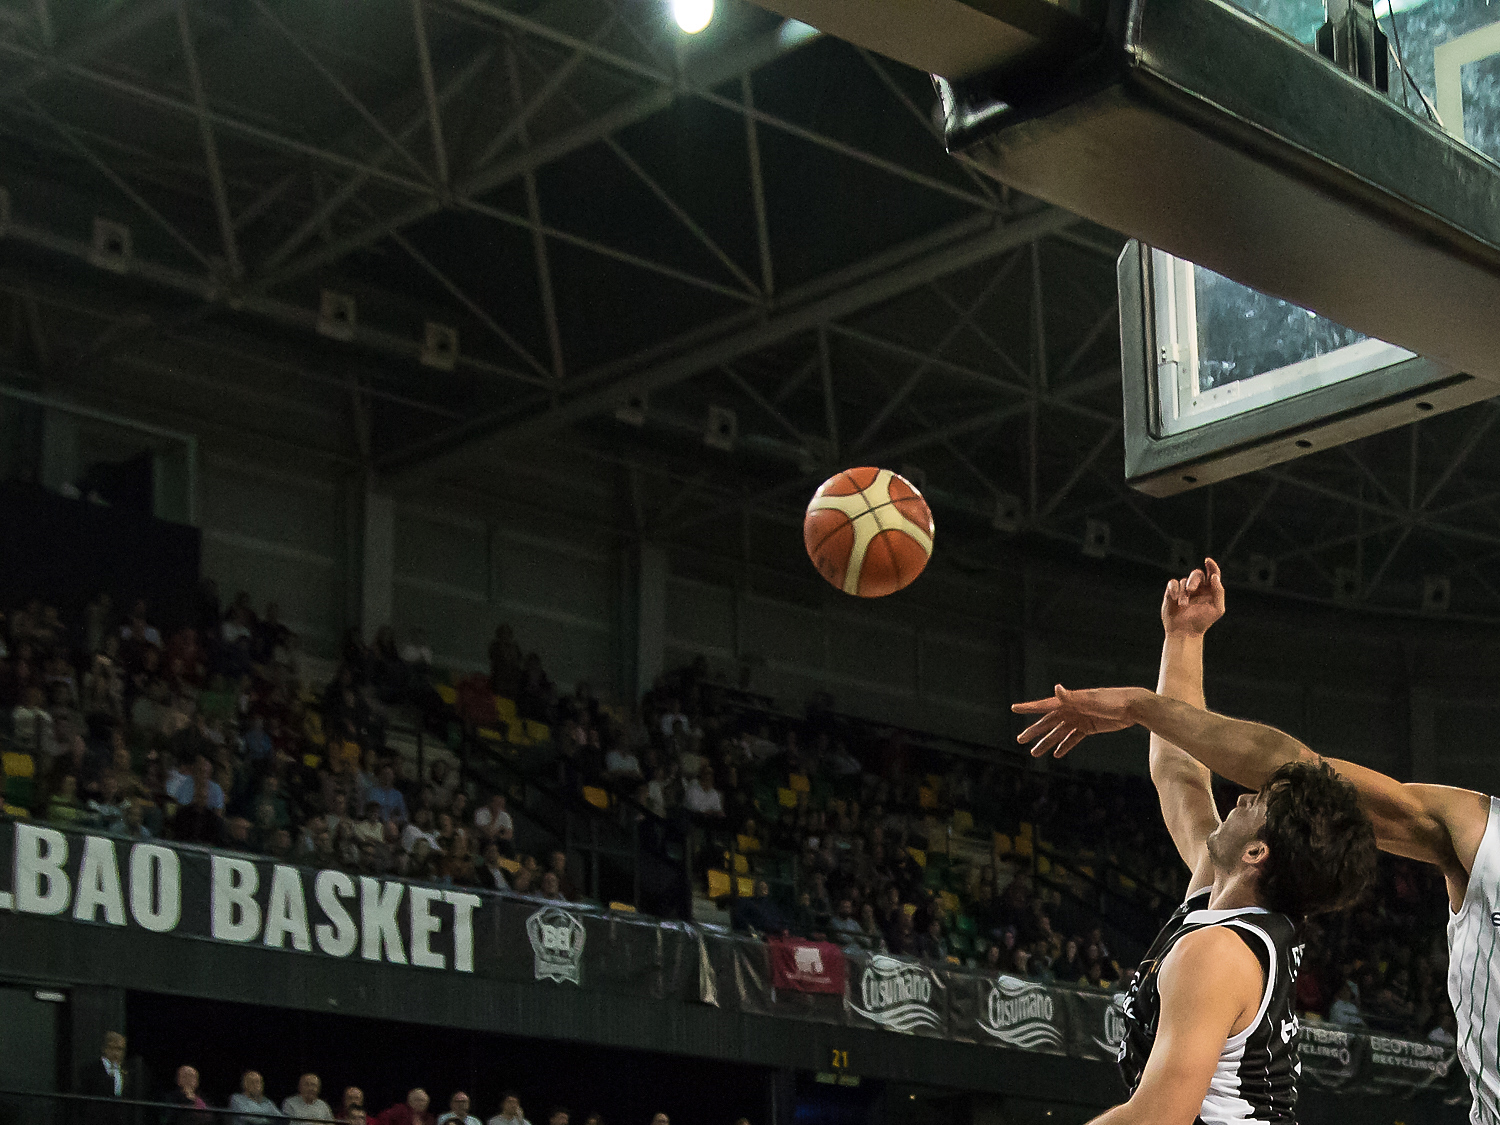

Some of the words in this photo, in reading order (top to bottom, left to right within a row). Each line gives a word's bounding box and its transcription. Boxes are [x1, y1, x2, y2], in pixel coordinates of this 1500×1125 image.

[0, 822, 182, 934] BAO
[210, 855, 482, 974] BASKET
[861, 966, 932, 1011] Cusumano
[988, 986, 1055, 1030] Cusumano
[832, 1049, 848, 1067] 21
